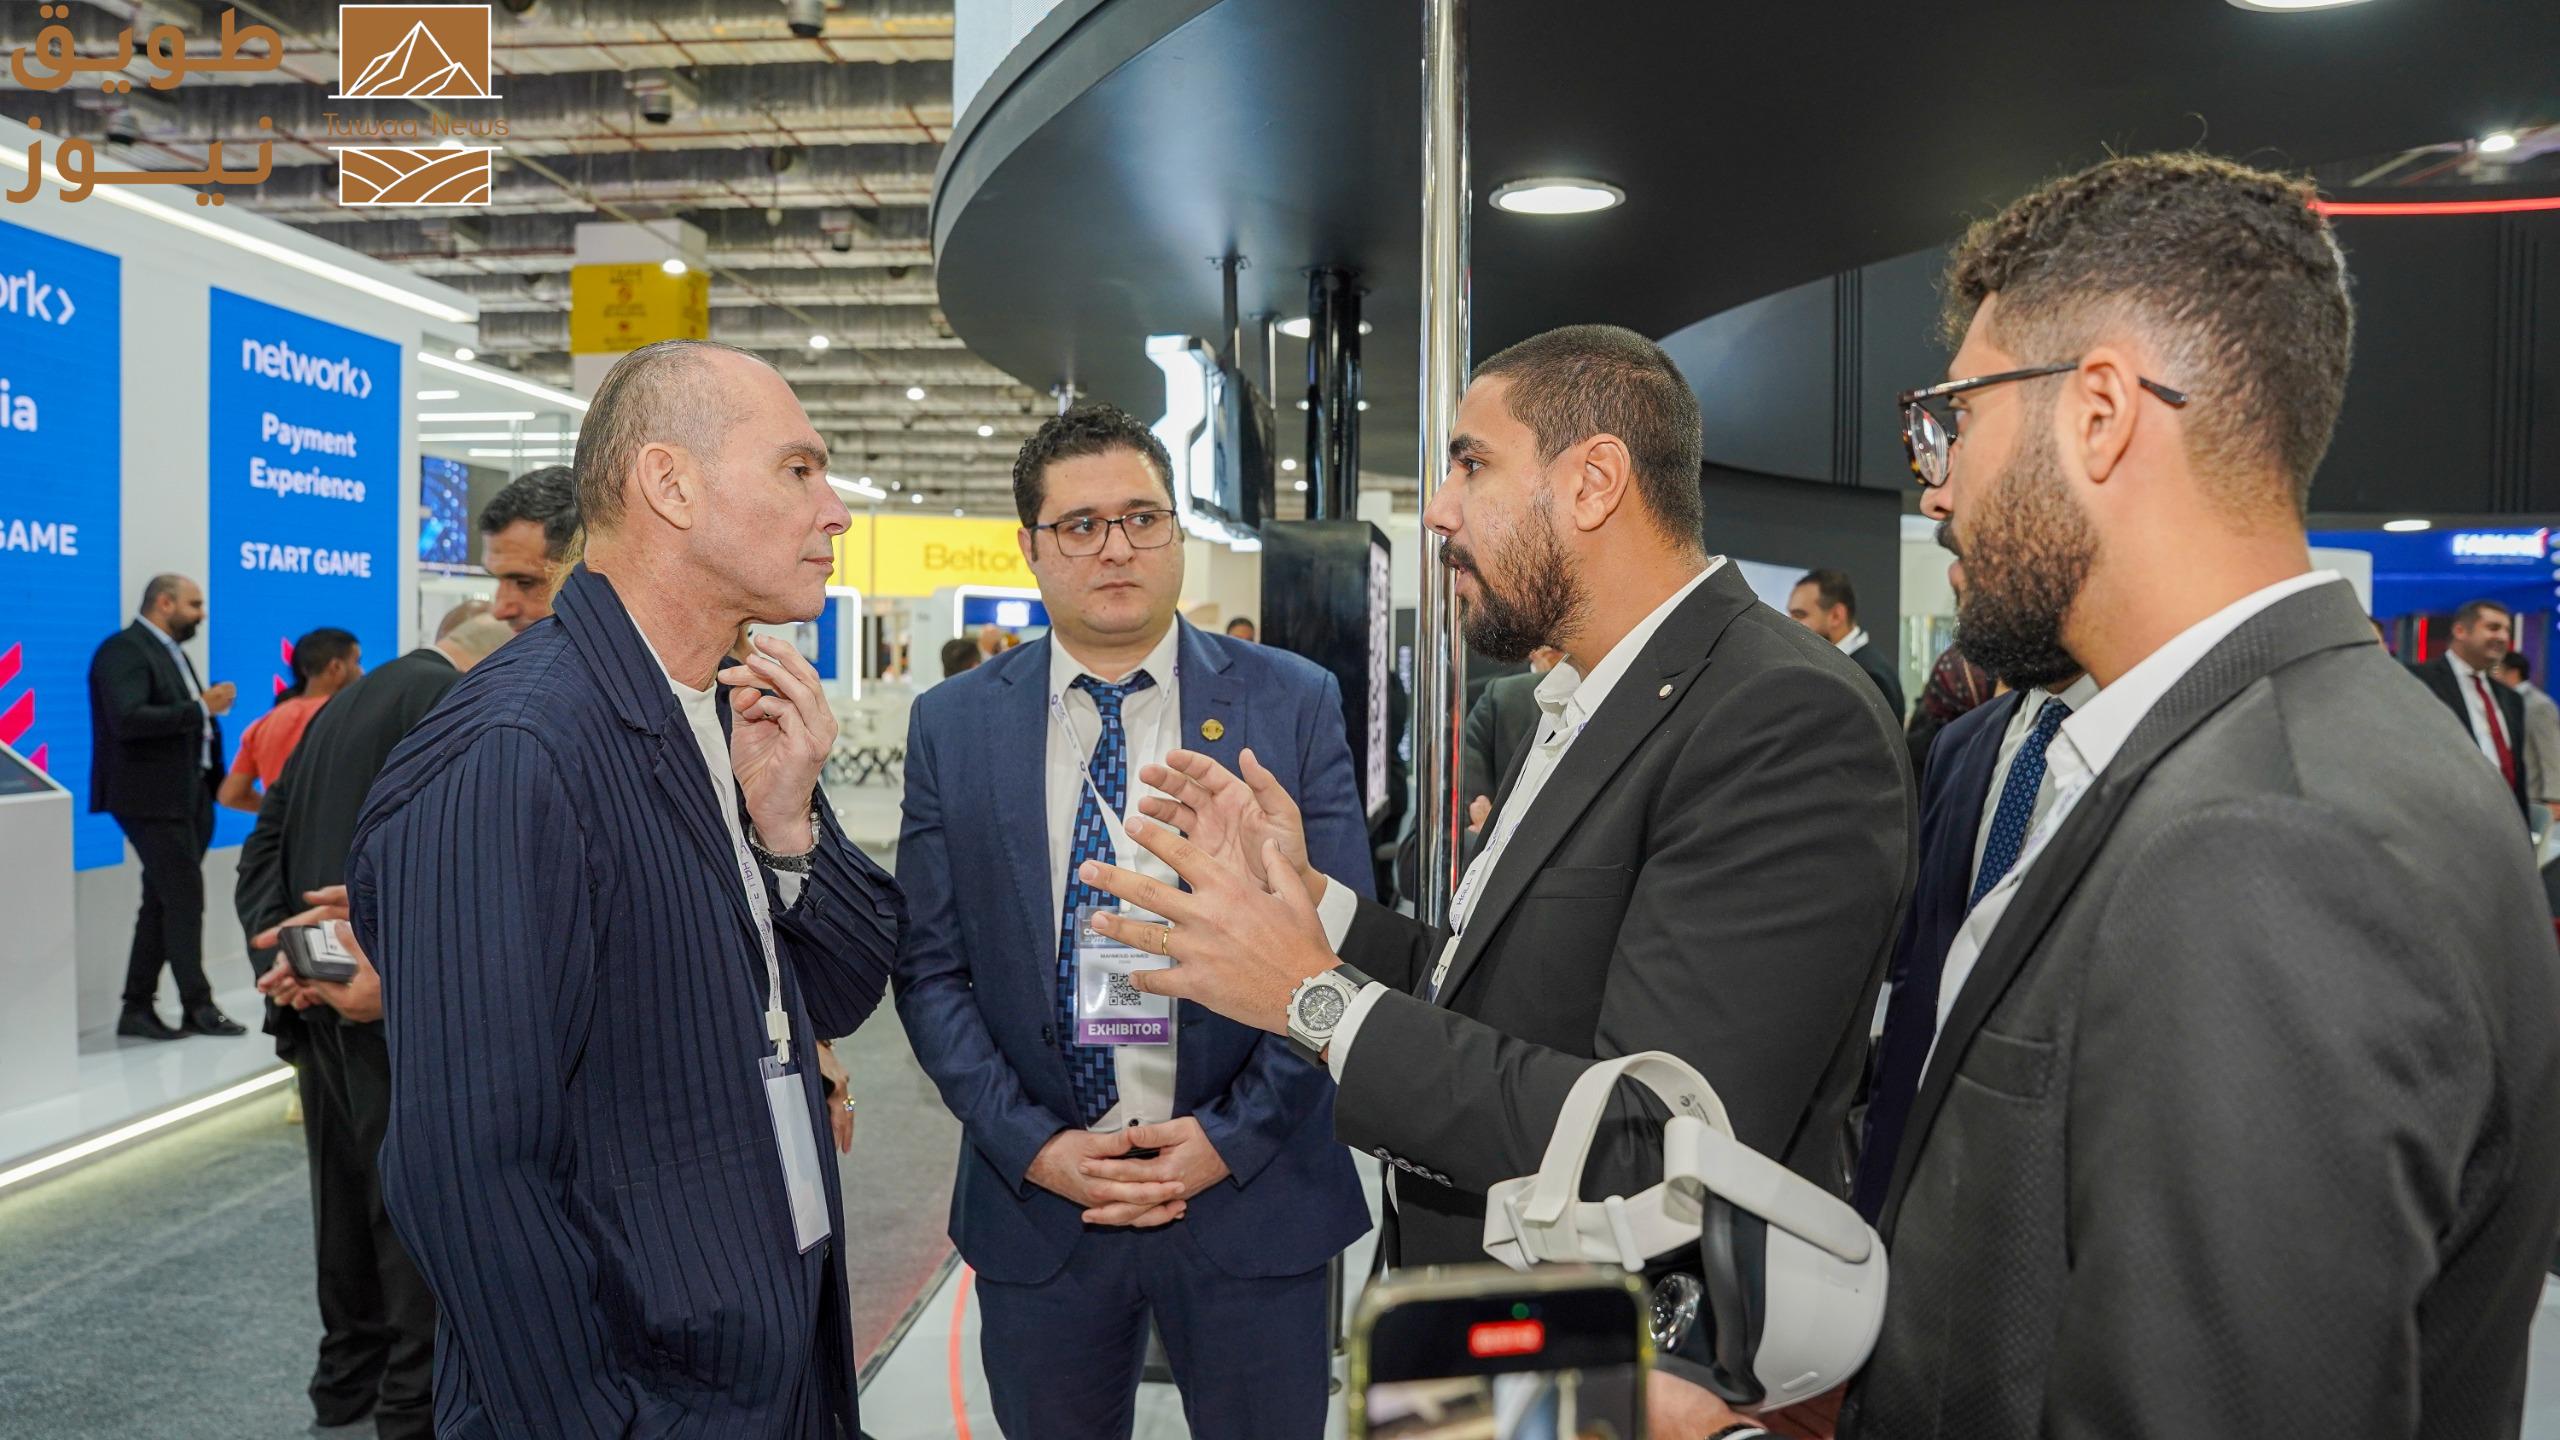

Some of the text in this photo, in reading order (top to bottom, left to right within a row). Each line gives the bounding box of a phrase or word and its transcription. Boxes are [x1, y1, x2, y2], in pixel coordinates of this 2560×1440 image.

[242, 337, 359, 398] network
[262, 411, 358, 458] Payment
[250, 456, 367, 503] Experience
[240, 541, 372, 578] START GAME
[1087, 1022, 1163, 1036] EXHIBITOR
